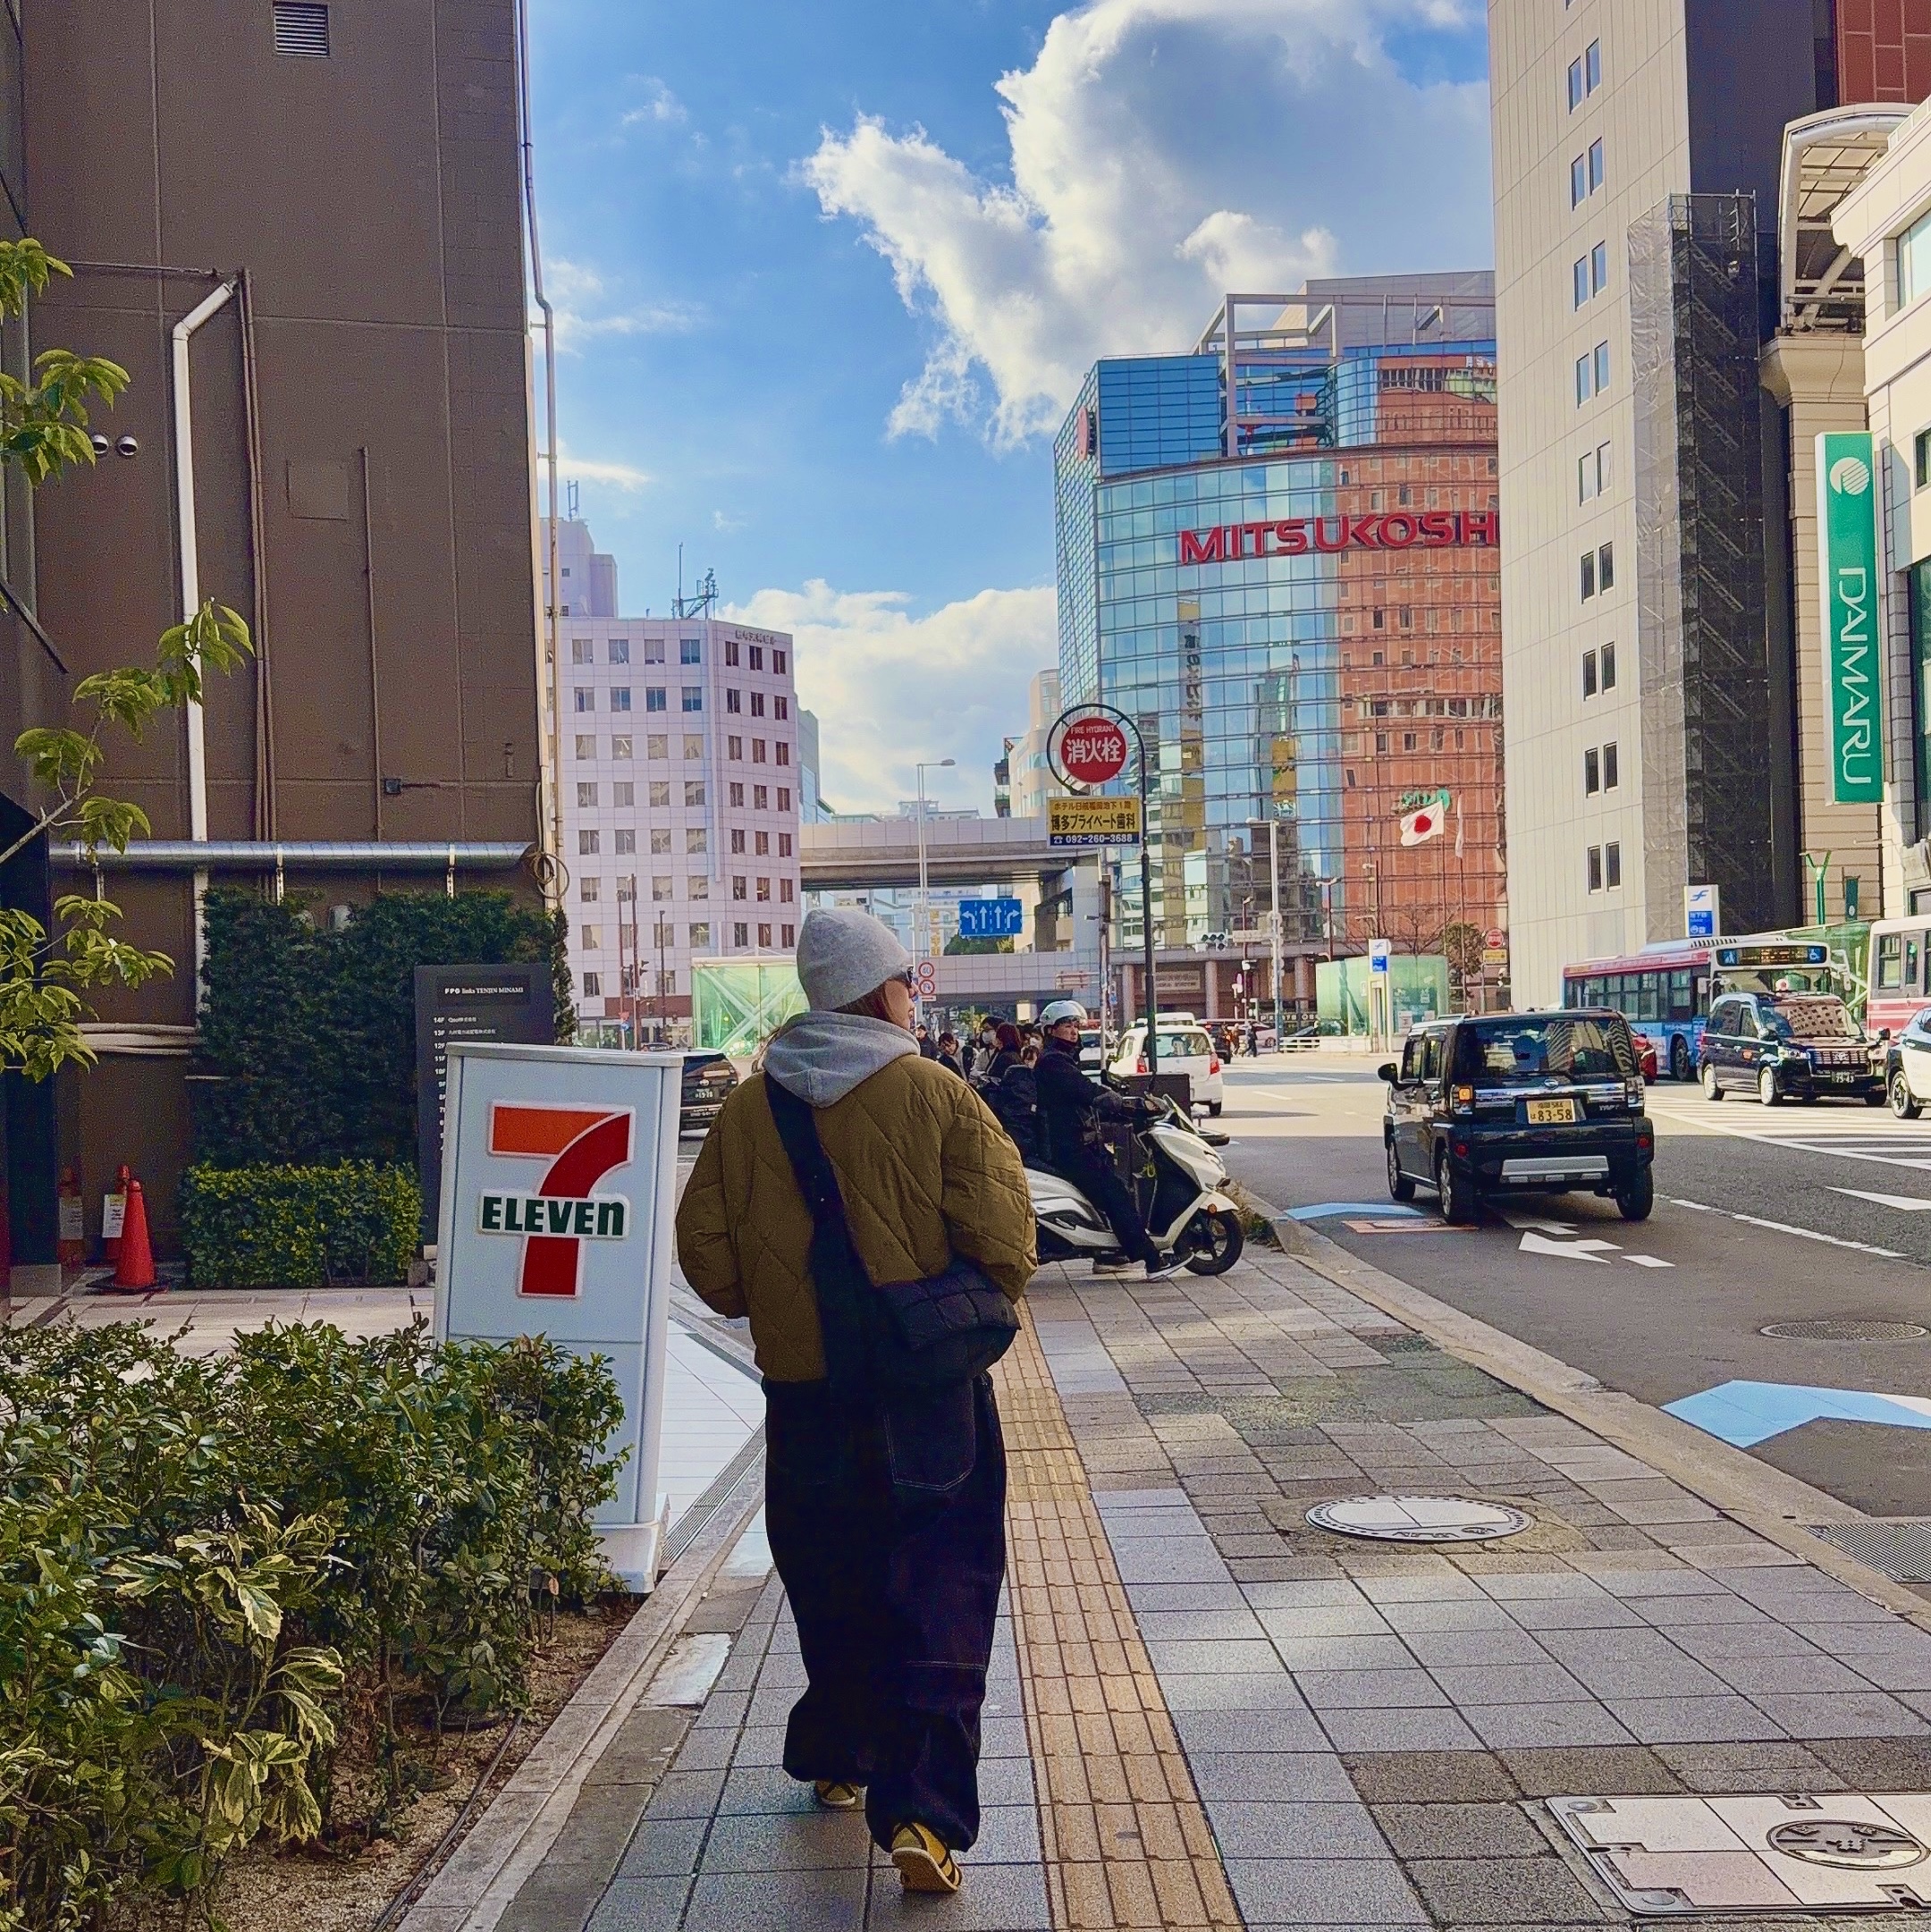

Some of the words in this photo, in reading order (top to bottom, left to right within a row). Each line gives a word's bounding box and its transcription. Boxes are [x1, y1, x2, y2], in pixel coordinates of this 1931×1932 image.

[1179, 510, 1498, 566] MITSUKOSH
[1839, 567, 1871, 783] DAIMARU
[1070, 726, 1085, 735] FIRE
[1086, 725, 1115, 734] HYDRANT
[1066, 737, 1122, 764] 消火栓
[1051, 813, 1135, 831] 博多プライベート歯科
[1538, 1109, 1572, 1122] 83-58
